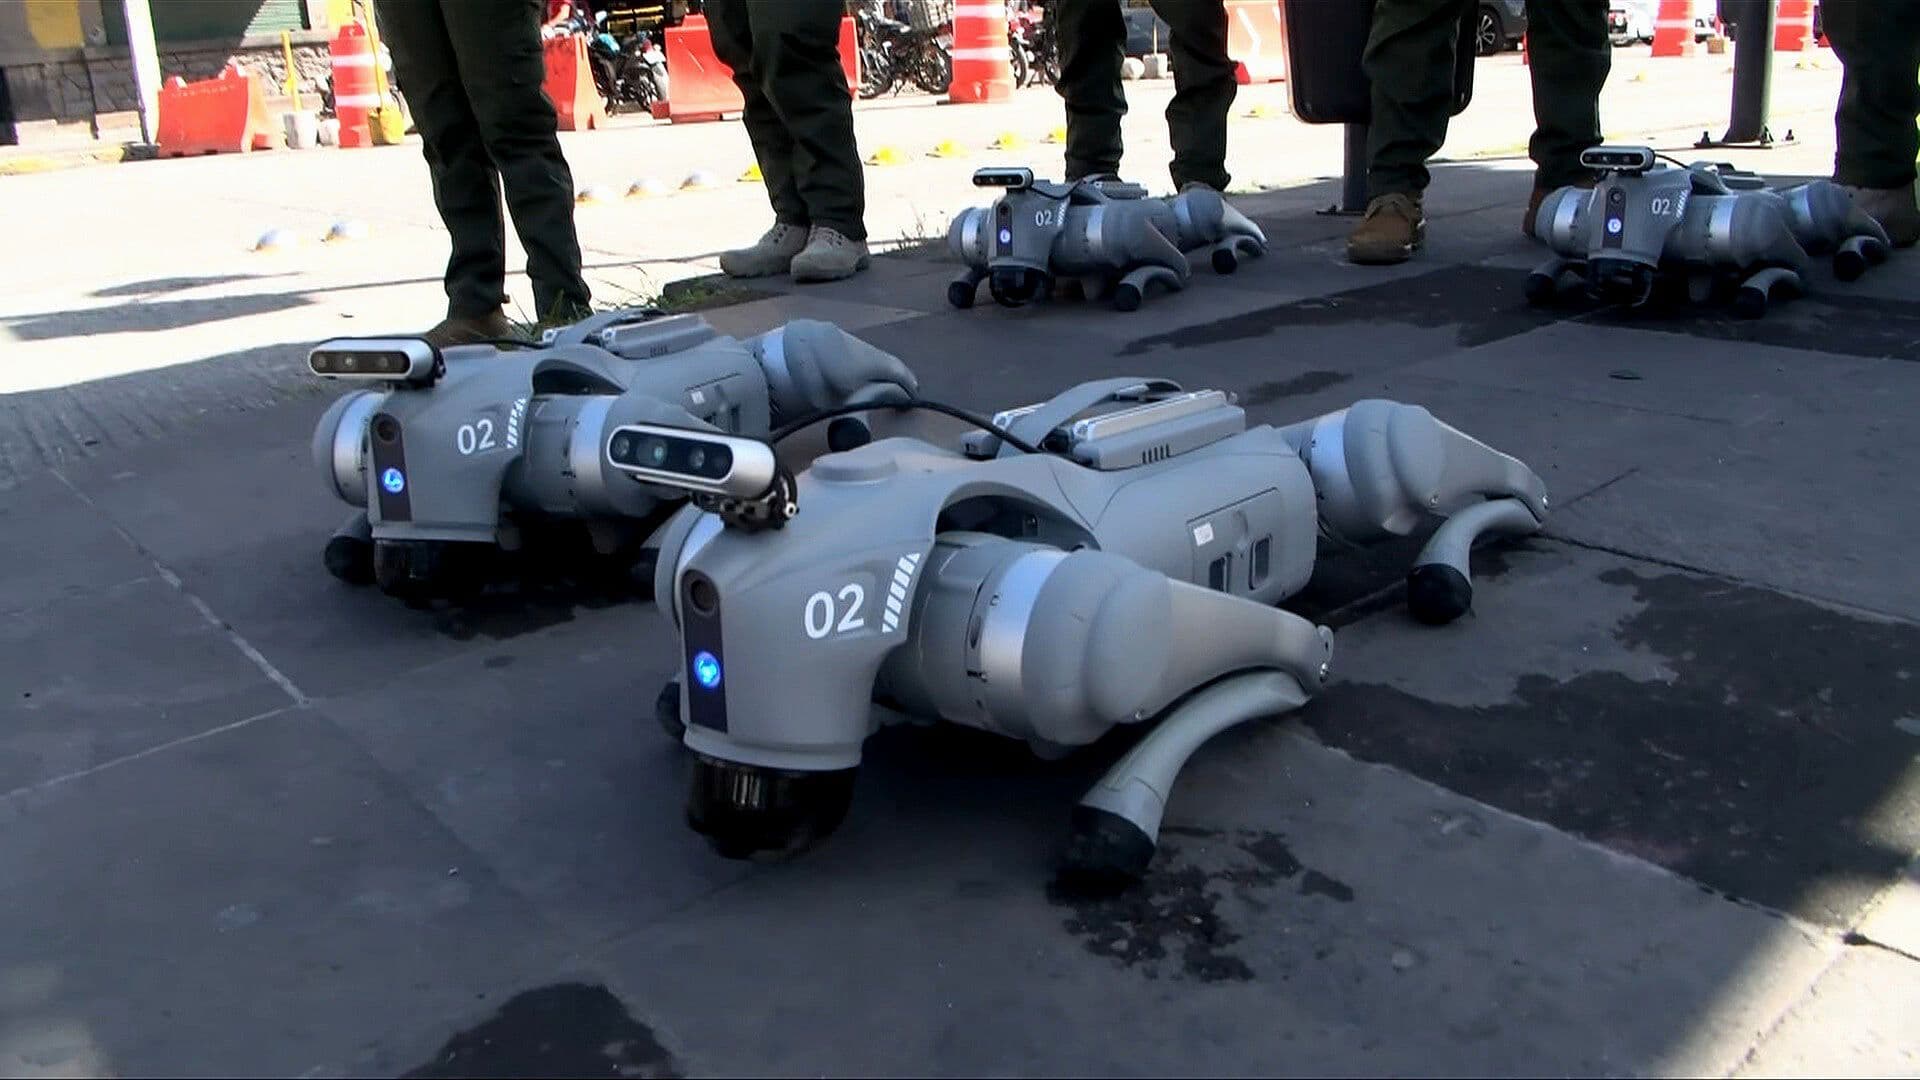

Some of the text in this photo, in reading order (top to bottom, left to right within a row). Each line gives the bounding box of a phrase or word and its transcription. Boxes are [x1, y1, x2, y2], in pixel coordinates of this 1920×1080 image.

[1035, 209, 1053, 227] 02
[1652, 198, 1671, 215] 02
[457, 418, 495, 455] 02
[804, 583, 864, 639] 02
